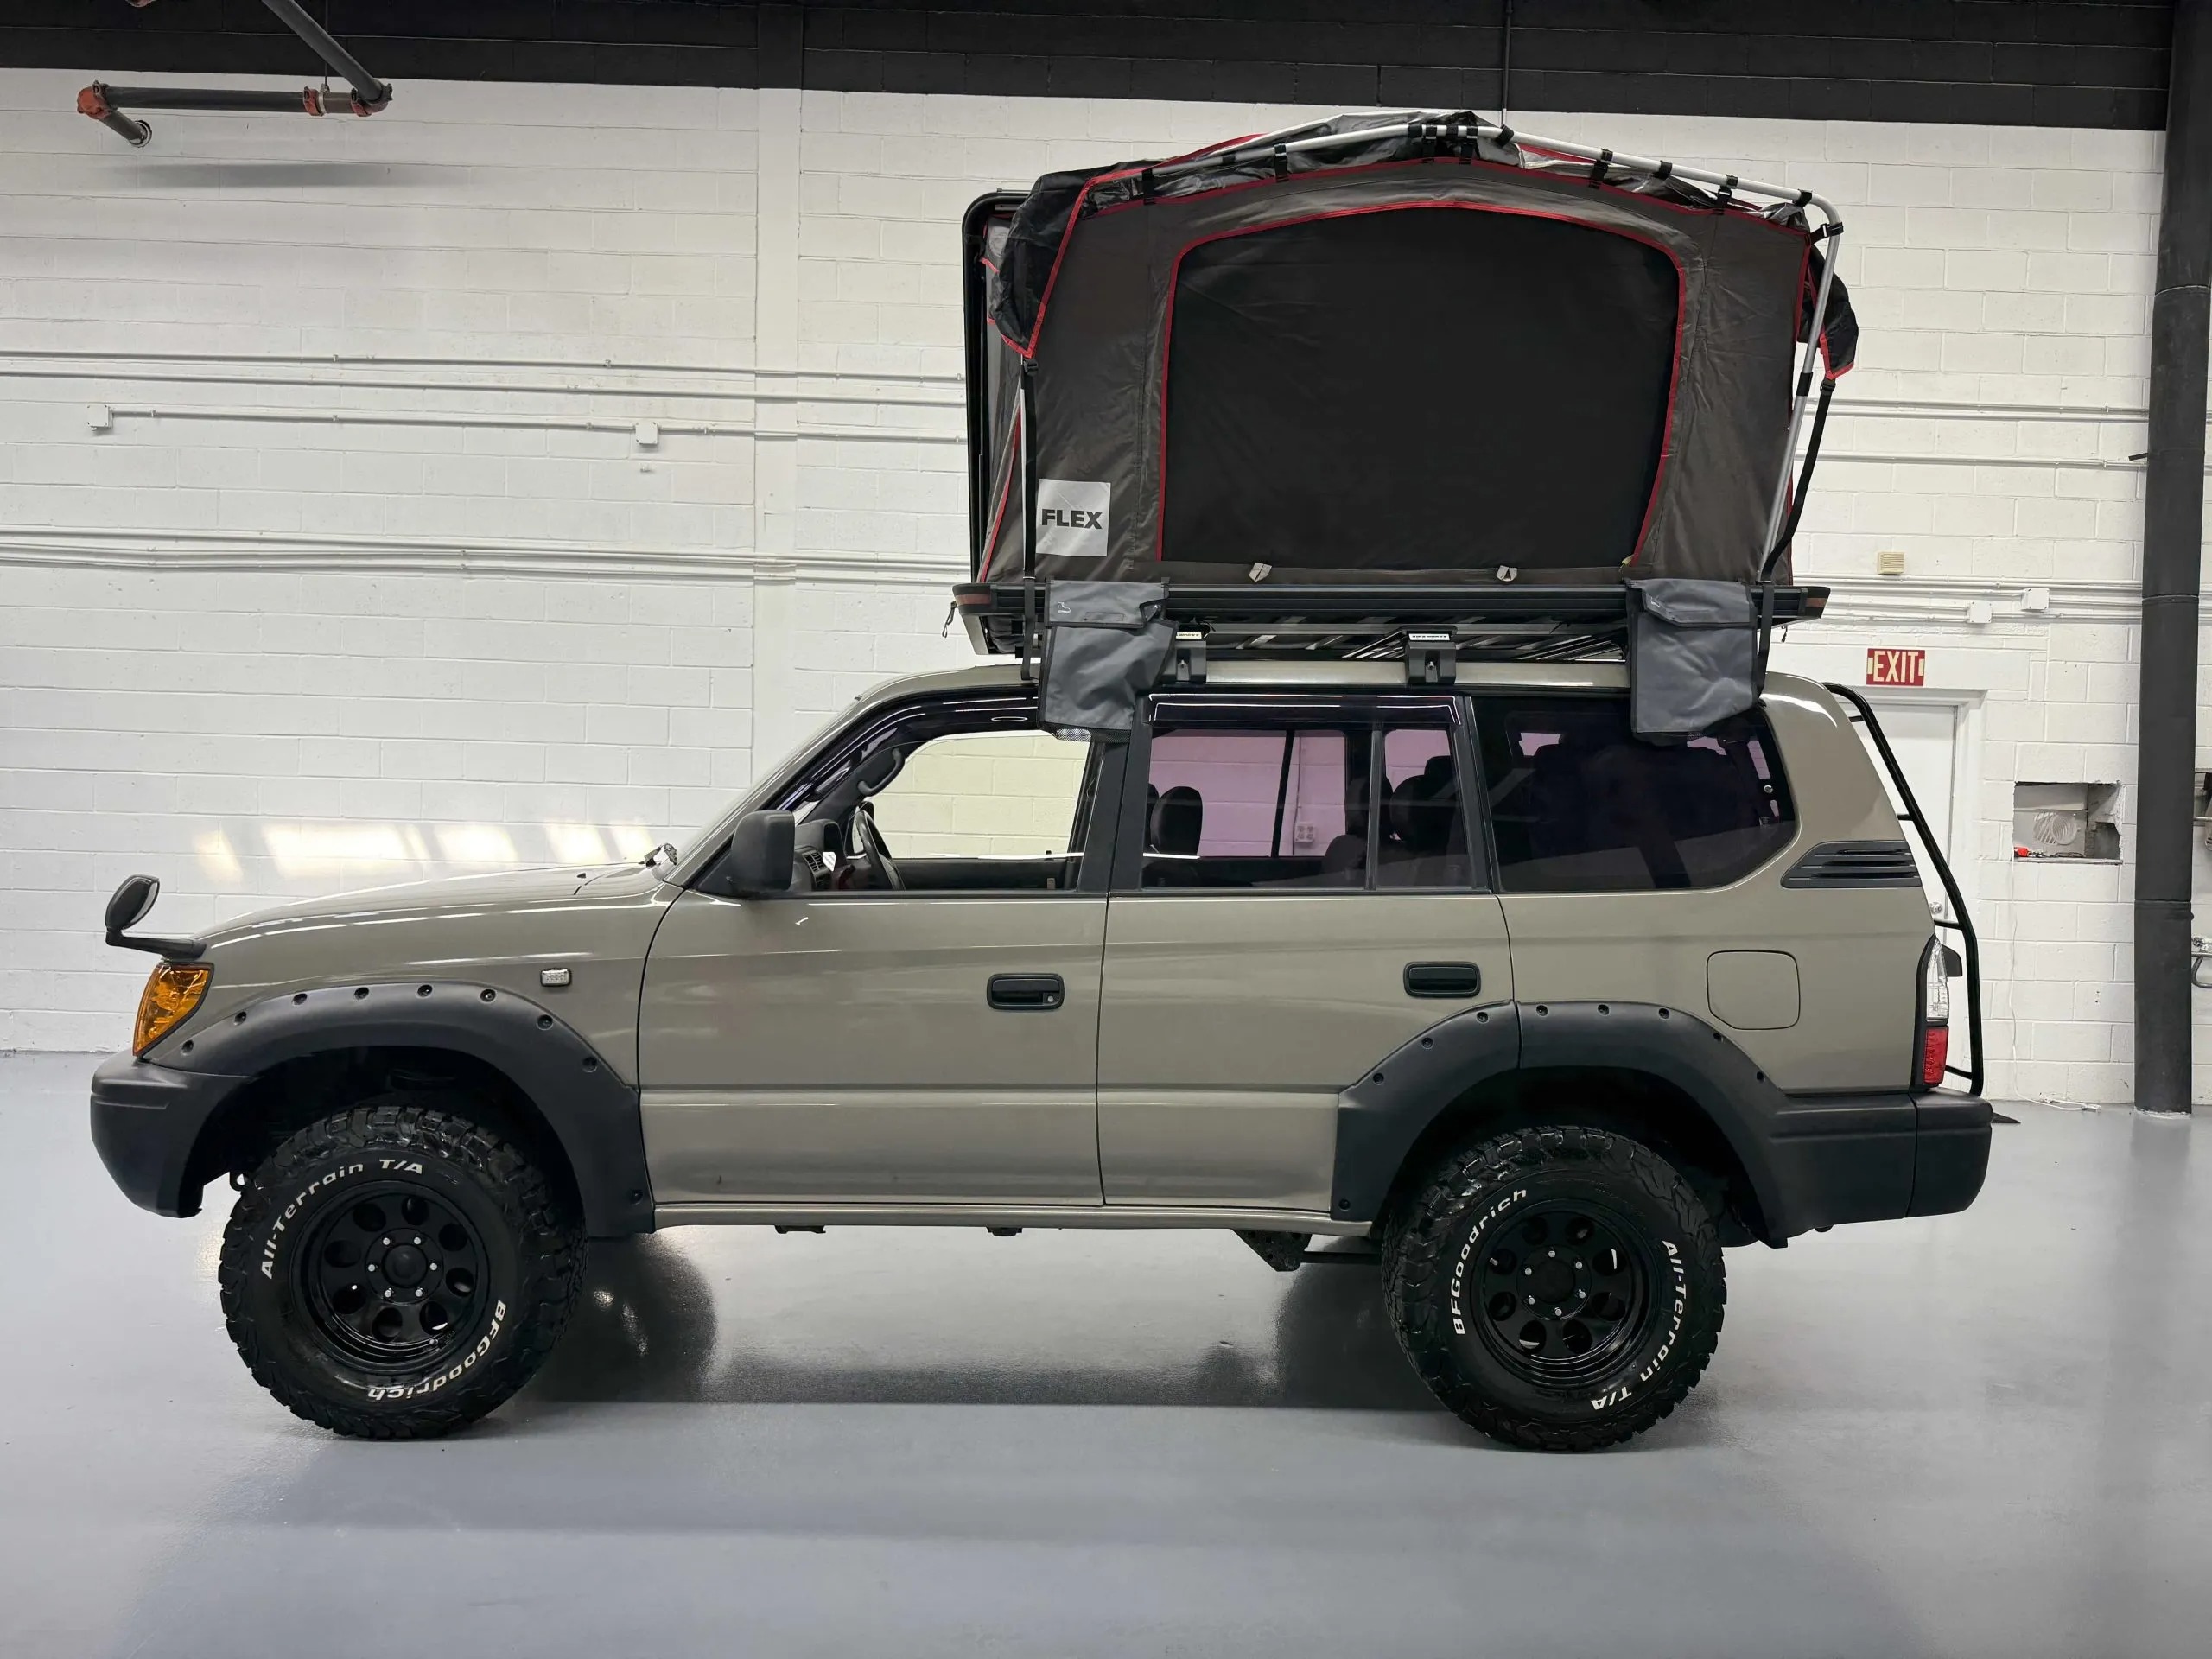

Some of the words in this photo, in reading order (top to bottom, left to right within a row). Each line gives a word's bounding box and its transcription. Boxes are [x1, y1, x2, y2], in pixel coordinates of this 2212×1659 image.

[1041, 508, 1103, 530] FLEX
[1873, 650, 1919, 683] EXIT
[261, 1162, 364, 1280] All-Terrain
[379, 1159, 423, 1175] T/A
[1451, 1189, 1528, 1335] BFGoodrich
[367, 1299, 506, 1401] BFGoodrich
[1640, 1240, 1687, 1382] All-Terrain
[1590, 1386, 1632, 1411] T/A
